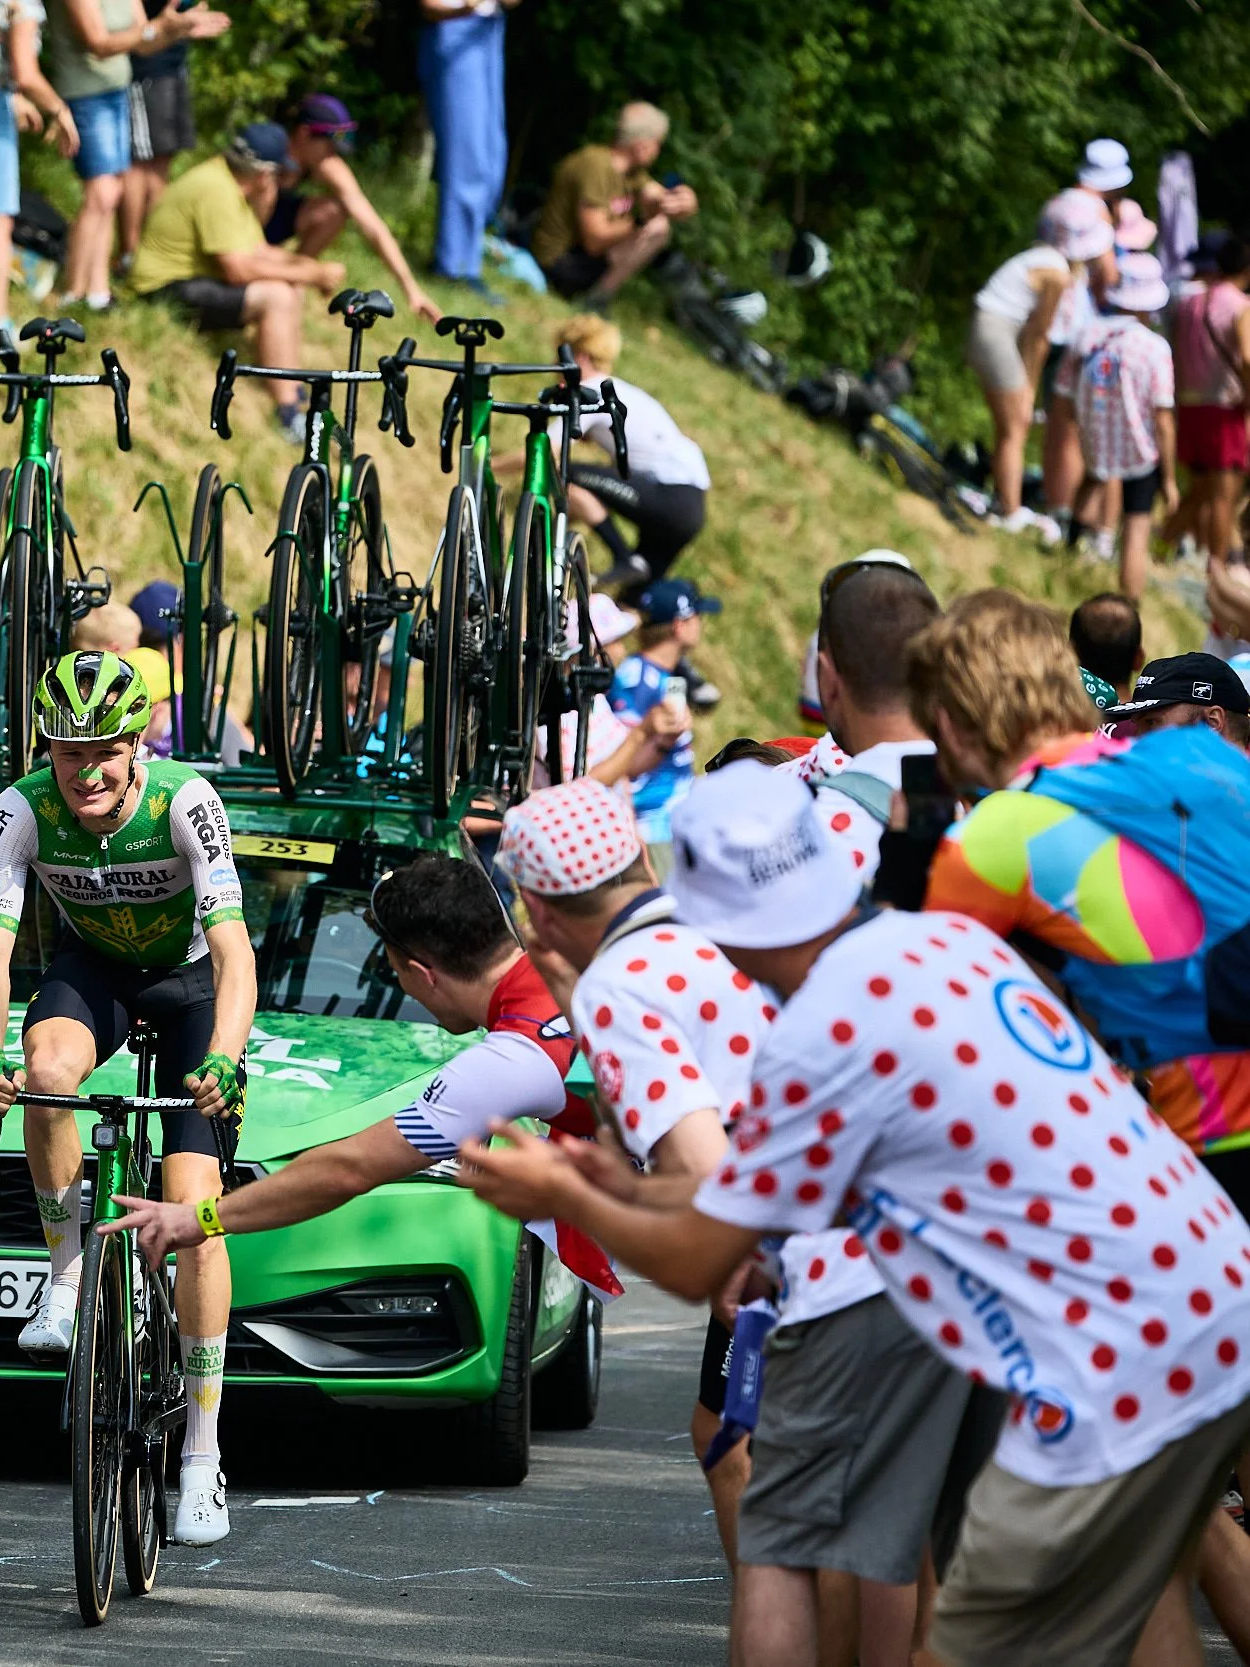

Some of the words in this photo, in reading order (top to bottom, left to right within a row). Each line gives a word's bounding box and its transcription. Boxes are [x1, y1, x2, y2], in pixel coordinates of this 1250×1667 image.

[187, 803, 221, 864] RGA
[207, 800, 231, 860] SEGUROS
[125, 835, 163, 851] GSPORT
[259, 840, 309, 855] 253
[47, 873, 101, 892] CAJA
[101, 869, 177, 887] RURAL
[58, 887, 114, 900] SEGUROS
[116, 886, 171, 899] RGA
[192, 1346, 220, 1357] CAJA
